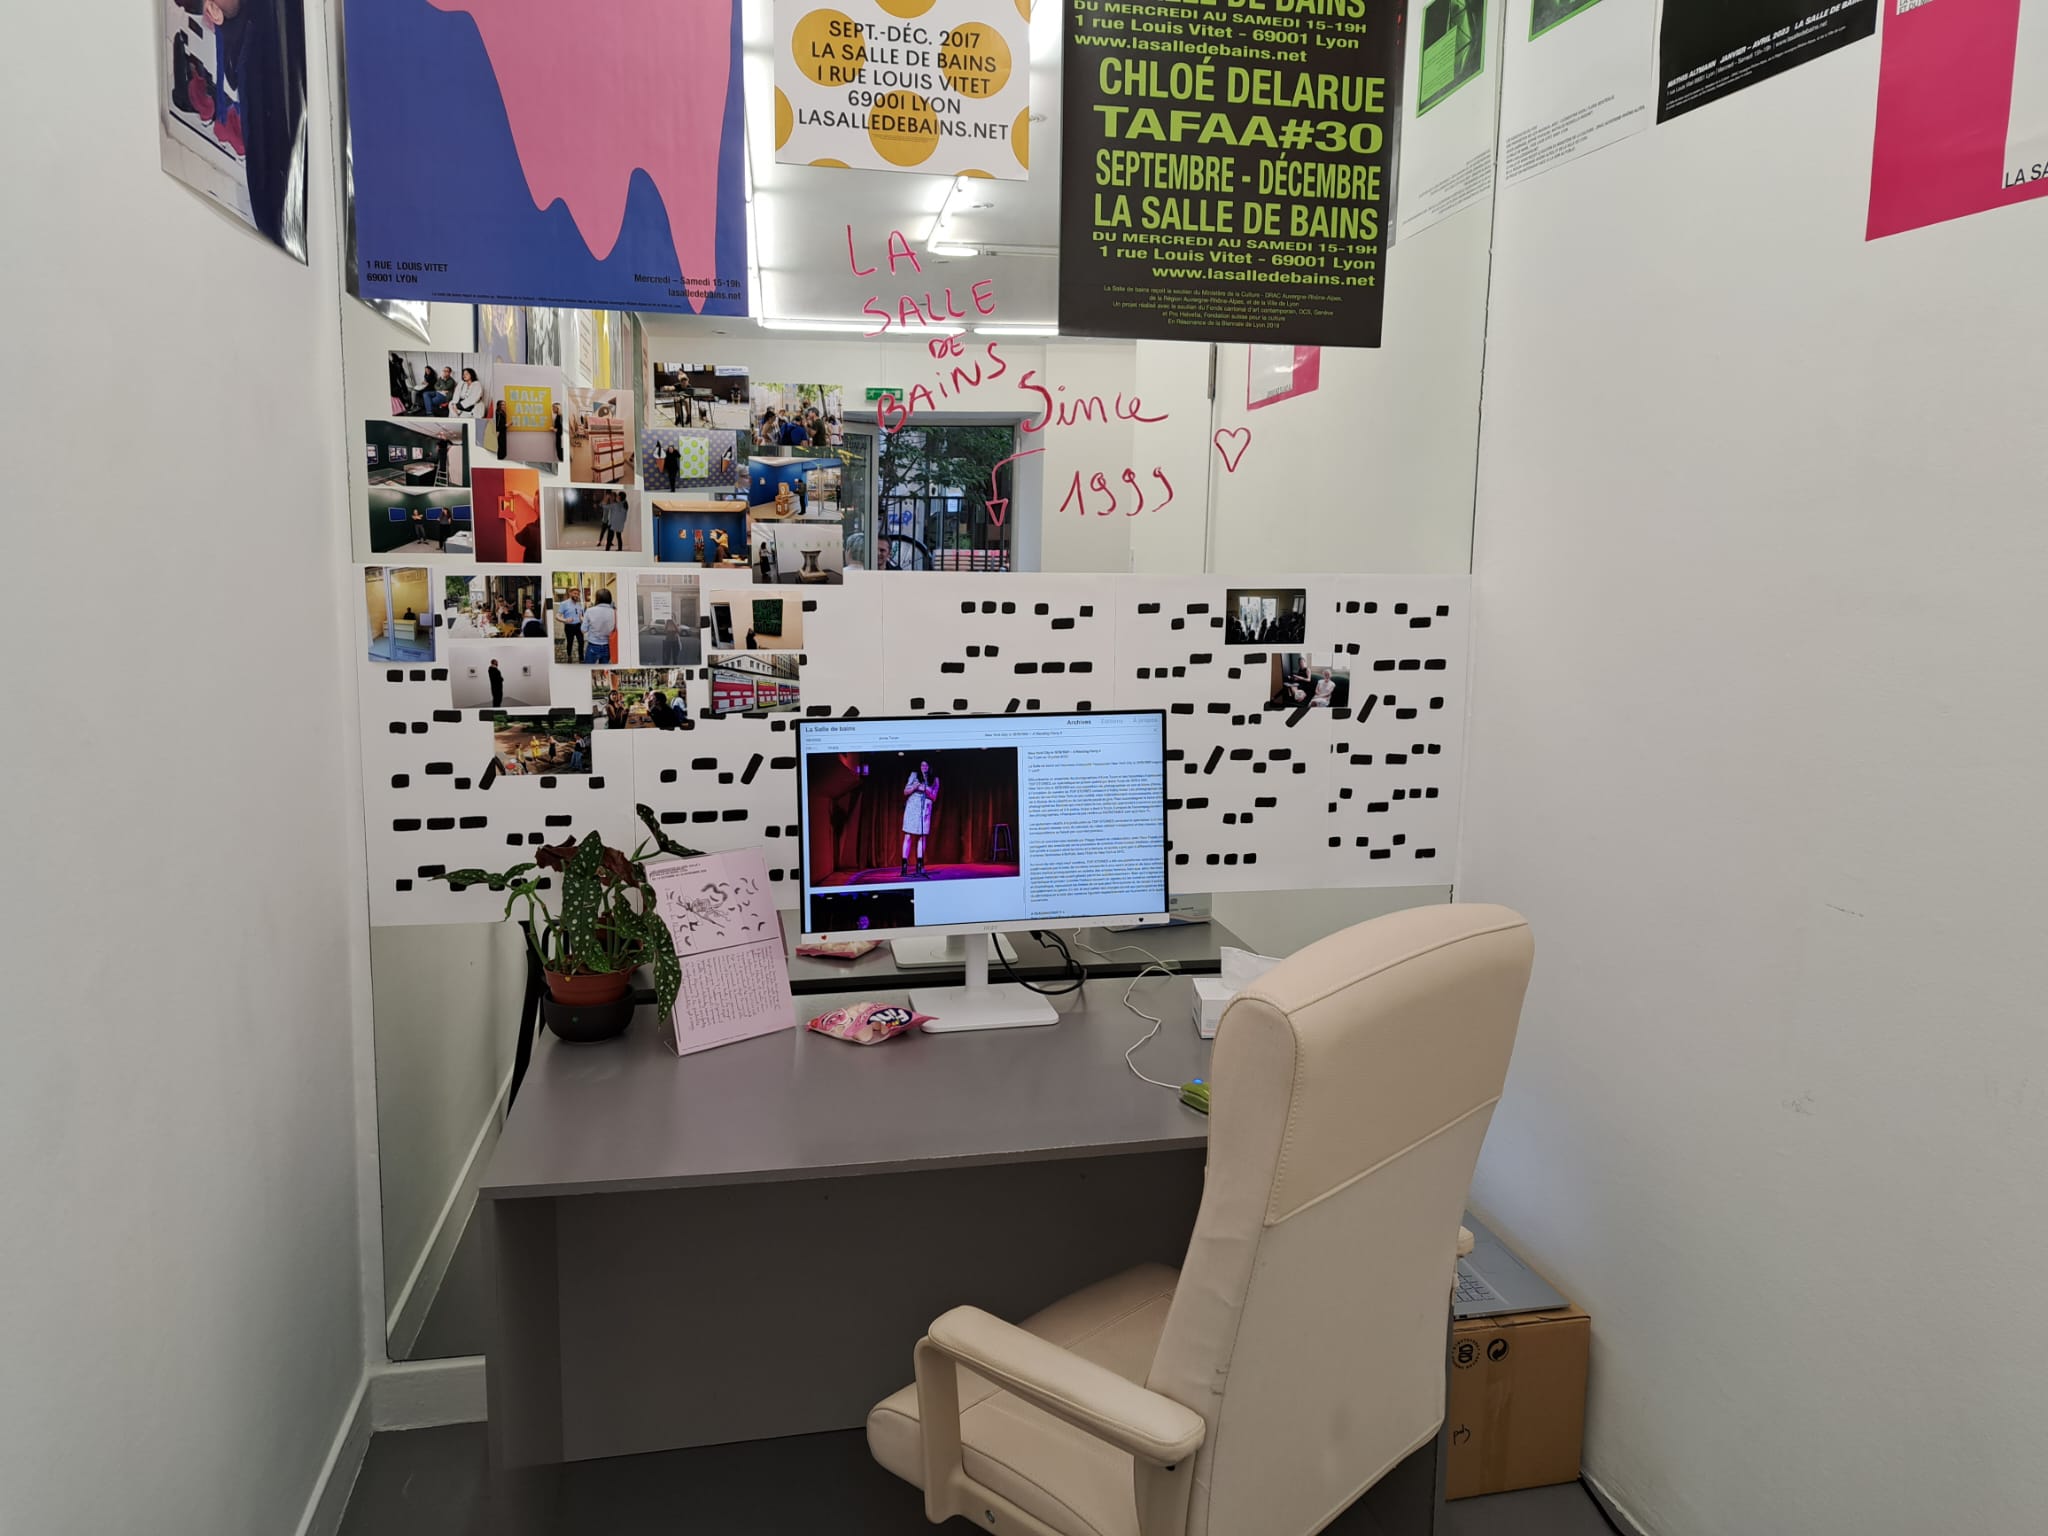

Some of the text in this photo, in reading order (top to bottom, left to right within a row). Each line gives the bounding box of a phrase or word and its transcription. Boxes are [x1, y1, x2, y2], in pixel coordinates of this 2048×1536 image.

[1074, 0, 1099, 12] DU
[1104, 2, 1198, 19] MERCREDI
[1203, 11, 1227, 22] AU
[1232, 13, 1300, 28] SAMEDI
[1307, 20, 1366, 34] 15-19H
[1794, 20, 1804, 30] LA
[1805, 8, 1830, 25] SALLE
[1830, 3, 1841, 15] DE
[829, 21, 980, 48] SEPT.-DÉC. 2017
[1075, 14, 1084, 26] 1
[1092, 18, 1124, 30] rue
[1132, 20, 1182, 35] Louis
[1189, 24, 1233, 38] Vitet
[1252, 28, 1308, 44] 69001
[1316, 35, 1359, 50] Lyon
[811, 41, 996, 72] LA SALLE DE BAINS
[1074, 34, 1308, 62] www.lasalledebains.net
[830, 66, 866, 84] RUE
[874, 70, 932, 90] LOUIS
[939, 76, 990, 94] VITET
[1099, 55, 1385, 113] CHLOÉ DELARUE
[848, 91, 961, 114] 69001 LYON
[798, 108, 1008, 140] LASALLEDEBAINS.NET
[1093, 104, 1383, 154] TAFAA#30
[1096, 148, 1234, 193] SEPTEMBRE
[1258, 152, 1382, 200] DÉCEMBRE
[2006, 168, 2025, 188] LA
[1094, 193, 1378, 241] LA SALLE DE BAINS
[847, 224, 923, 277] LA
[1092, 231, 1378, 255] DU MERCREDI AU SAMEDI 15-19H
[366, 260, 448, 272] 1 RUE LOUIS VITET
[1100, 246, 1108, 258] 1
[1116, 249, 1148, 259] rue
[1154, 248, 1204, 262] Louis
[1210, 251, 1252, 264] Vitet
[1272, 254, 1326, 268] 69001
[1332, 258, 1376, 271] Lyon
[366, 273, 418, 284] 69001 LYON
[634, 274, 670, 284] Mercredi
[680, 277, 710, 286] Samedi
[714, 279, 740, 288] 15-19h
[1152, 267, 1376, 287] www.lasalledebains.net
[668, 288, 741, 300] lasalledebains.net
[862, 279, 997, 338] SALLE
[927, 333, 966, 359] DE
[1018, 370, 1169, 433] Since
[1060, 466, 1174, 518] 1999
